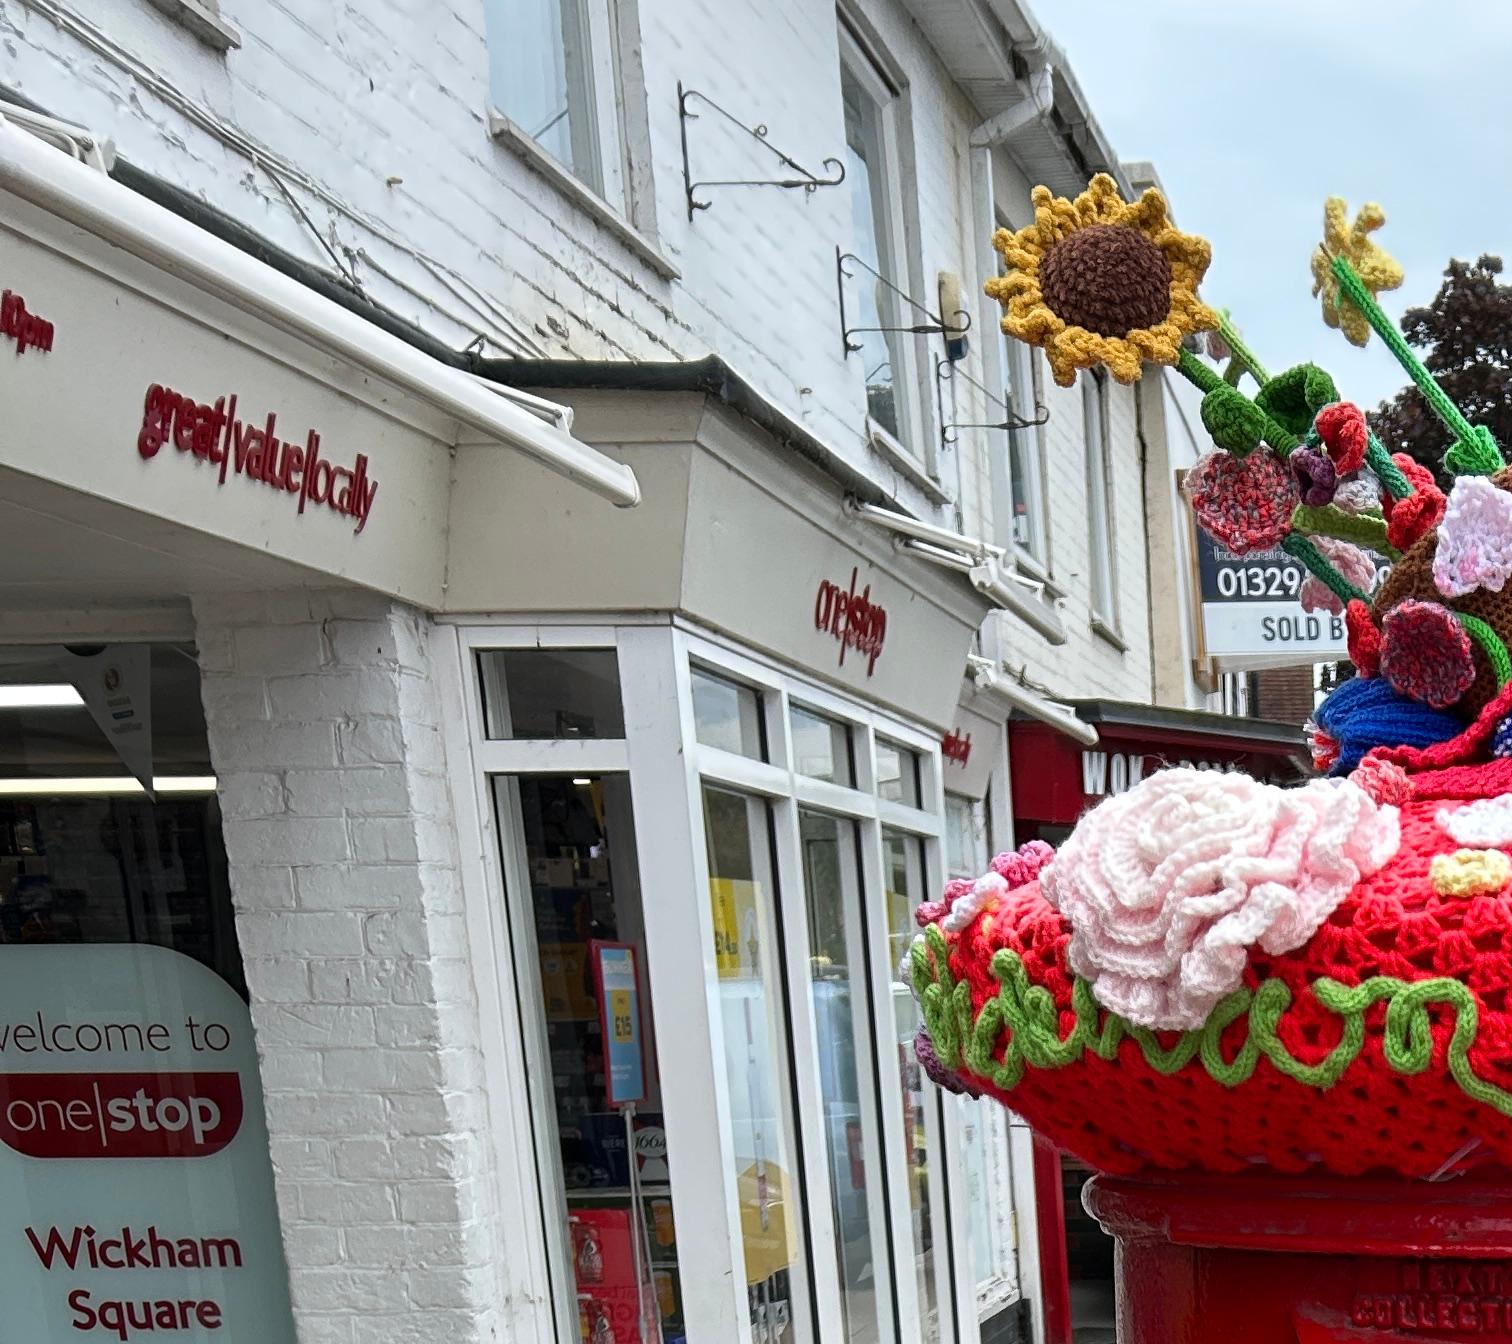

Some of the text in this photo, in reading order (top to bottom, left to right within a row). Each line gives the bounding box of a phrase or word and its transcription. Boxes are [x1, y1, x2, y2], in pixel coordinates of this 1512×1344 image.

[1217, 567, 1300, 597] 01329
[1261, 616, 1344, 641] SOLD B
[190, 1016, 230, 1053] to
[635, 1135, 666, 1150] 1664
[25, 1225, 242, 1270] Wickham
[67, 1289, 223, 1341] Square
